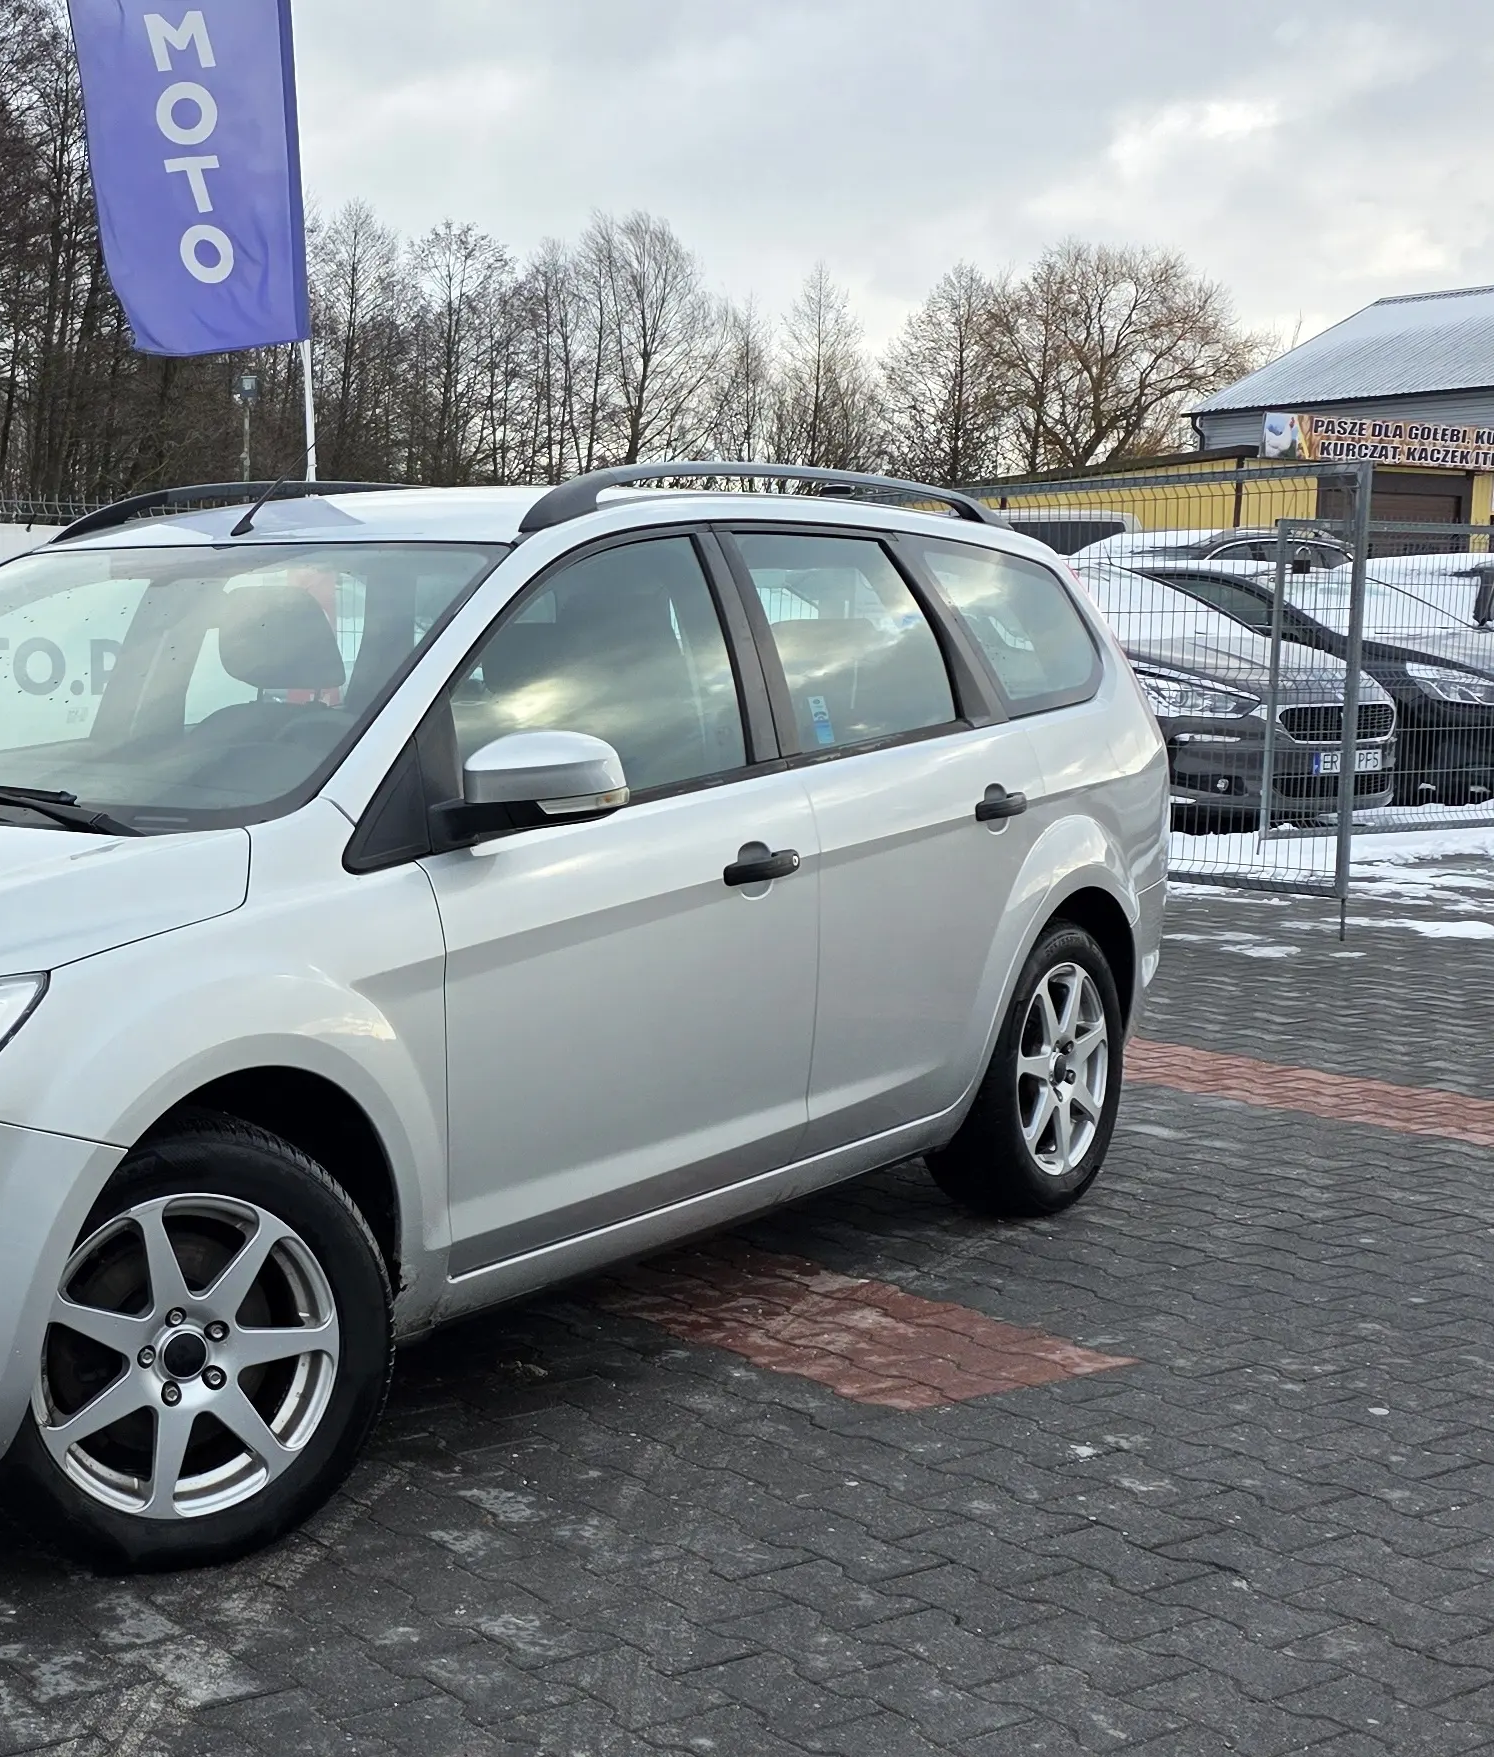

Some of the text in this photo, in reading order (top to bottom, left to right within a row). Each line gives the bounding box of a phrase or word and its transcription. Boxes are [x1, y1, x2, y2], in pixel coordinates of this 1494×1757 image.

[144, 11, 234, 284] MOTO
[1313, 419, 1368, 437] PASZE
[1371, 422, 1404, 440] DLA
[1406, 446, 1471, 465] KACZEK
